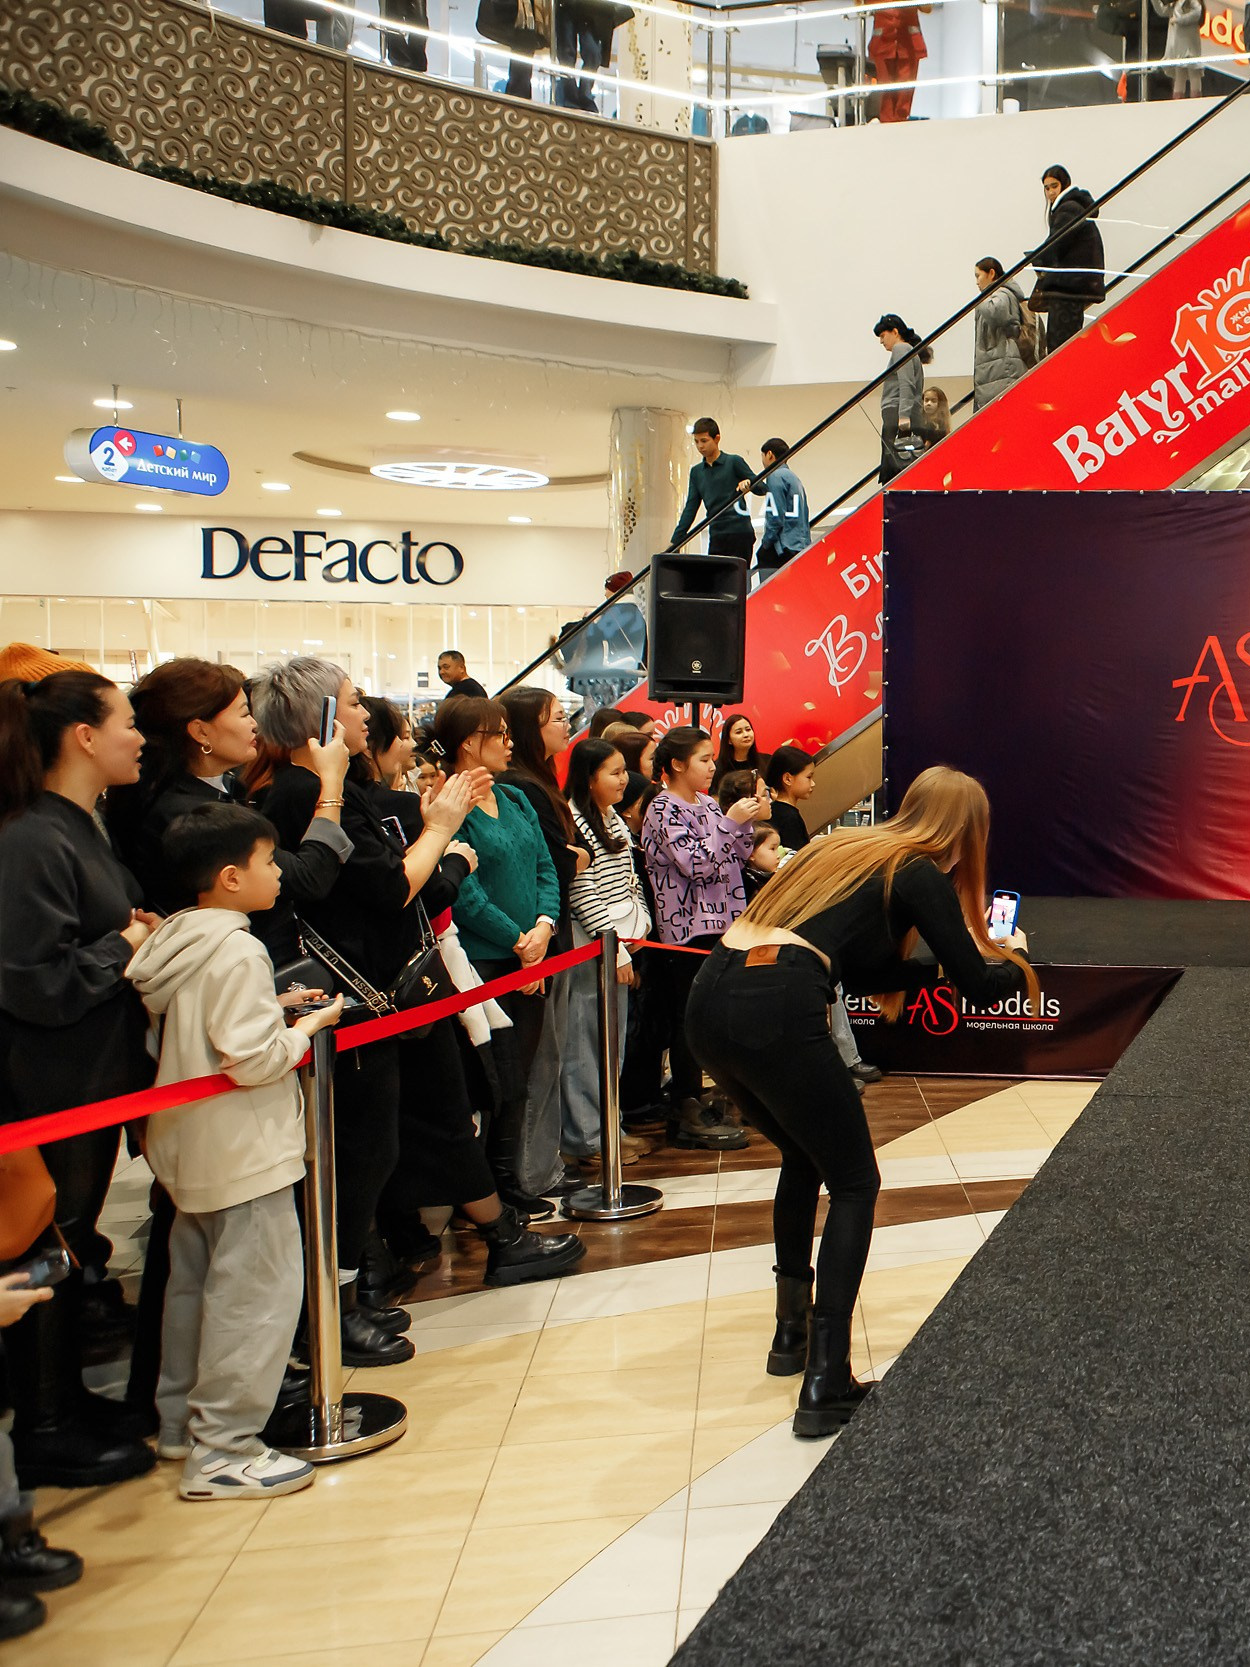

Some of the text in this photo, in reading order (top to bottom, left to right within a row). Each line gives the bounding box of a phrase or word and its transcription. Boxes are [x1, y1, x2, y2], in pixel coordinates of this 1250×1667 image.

[1052, 361, 1195, 484] Batyr
[103, 447, 115, 467] 2
[136, 459, 218, 487] Детский мир
[201, 527, 464, 586] DeFacto
[845, 994, 881, 1011] els
[907, 986, 959, 1036] AS
[966, 1020, 1054, 1031] модельная школа
